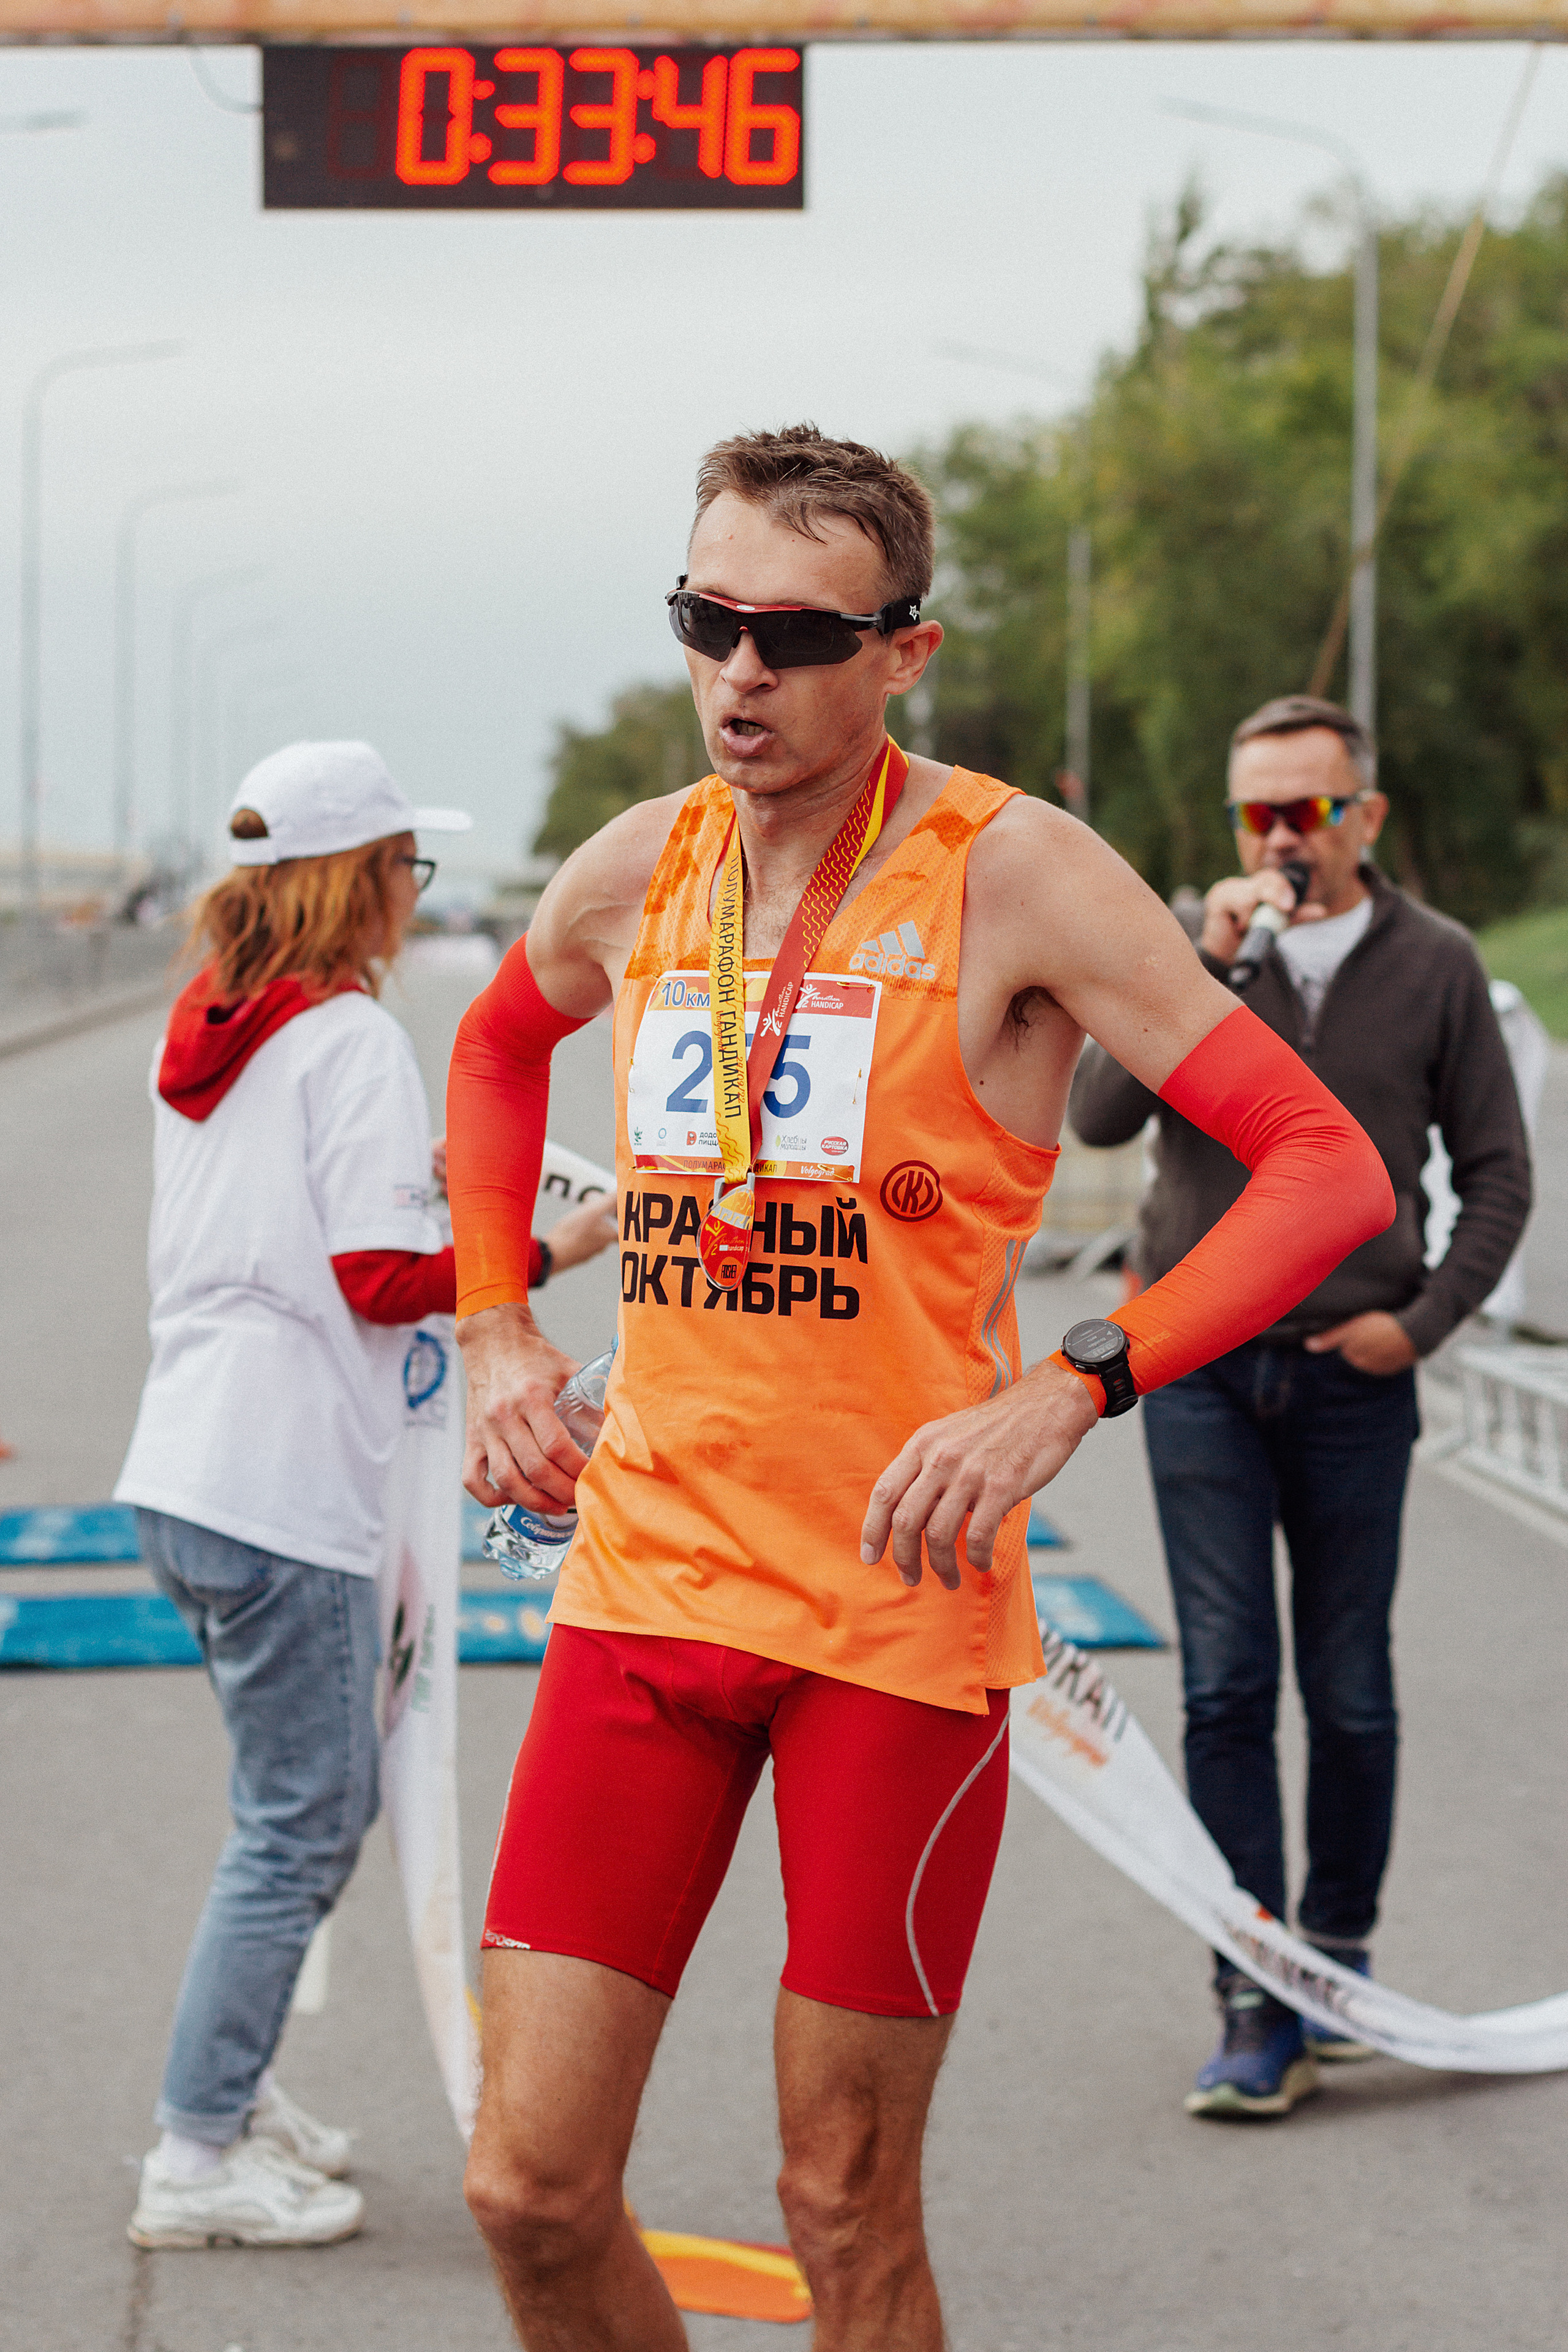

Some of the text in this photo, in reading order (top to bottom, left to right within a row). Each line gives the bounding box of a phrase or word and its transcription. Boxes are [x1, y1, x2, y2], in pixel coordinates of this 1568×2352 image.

[396, 48, 801, 185] 0:33:46
[779, 982, 794, 1017] HANDICAP
[849, 953, 935, 979] adidas
[811, 1001, 844, 1009] HANDICAP
[666, 1030, 812, 1118] 25
[718, 1011, 742, 1118] ГАНДИКАП
[623, 1191, 869, 1264] КРАНЫЙ
